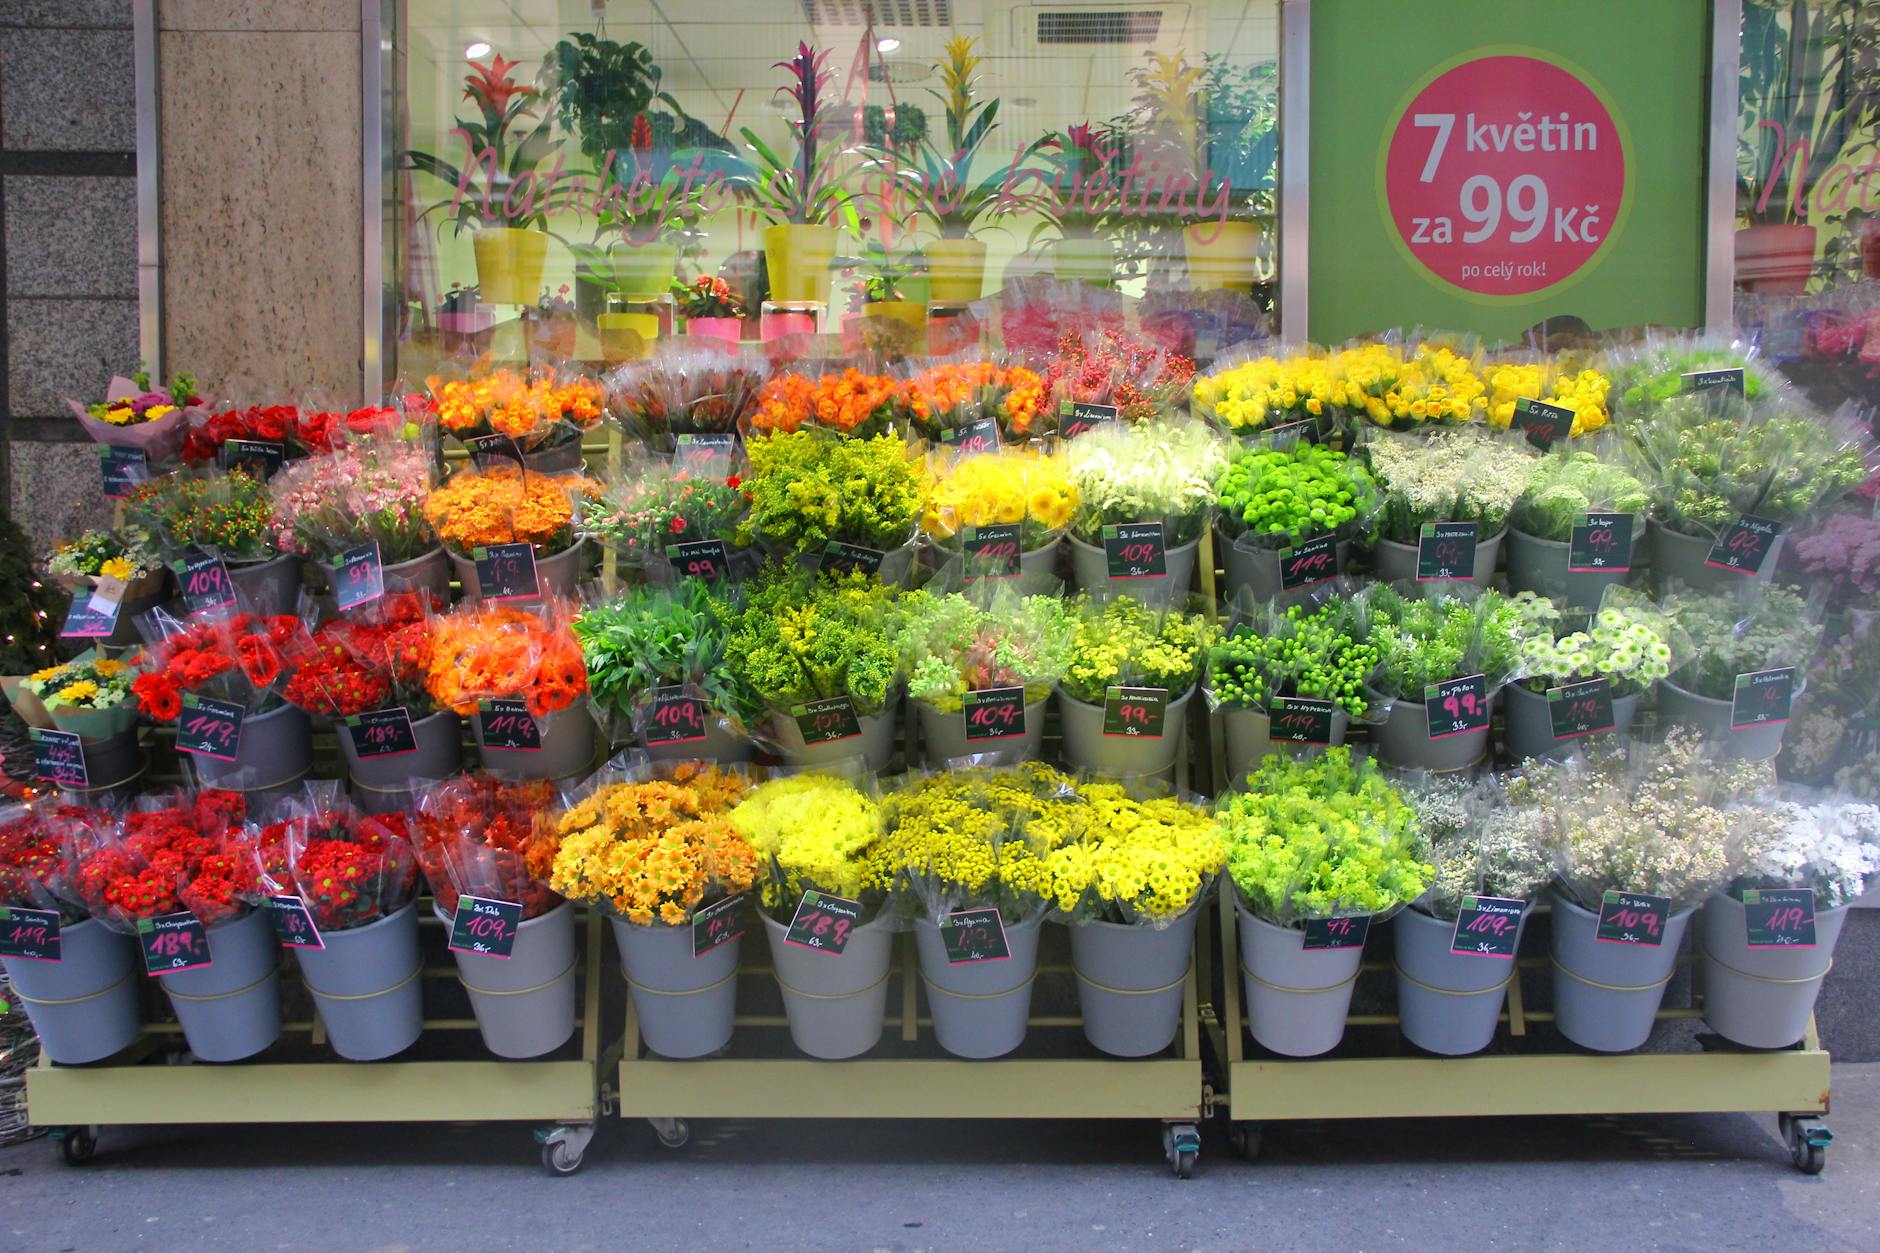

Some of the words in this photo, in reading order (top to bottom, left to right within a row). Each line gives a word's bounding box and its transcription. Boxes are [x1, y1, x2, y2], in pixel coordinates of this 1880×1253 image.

[1413, 112, 1456, 184] 7
[1466, 111, 1598, 152] květin
[1001, 142, 1232, 245] květiny
[1410, 215, 1453, 245] za
[1459, 174, 1550, 245] 99
[1554, 204, 1600, 244] Kč
[1461, 265, 1481, 280] po
[1484, 261, 1514, 280] celý
[1517, 261, 1547, 278] rok!
